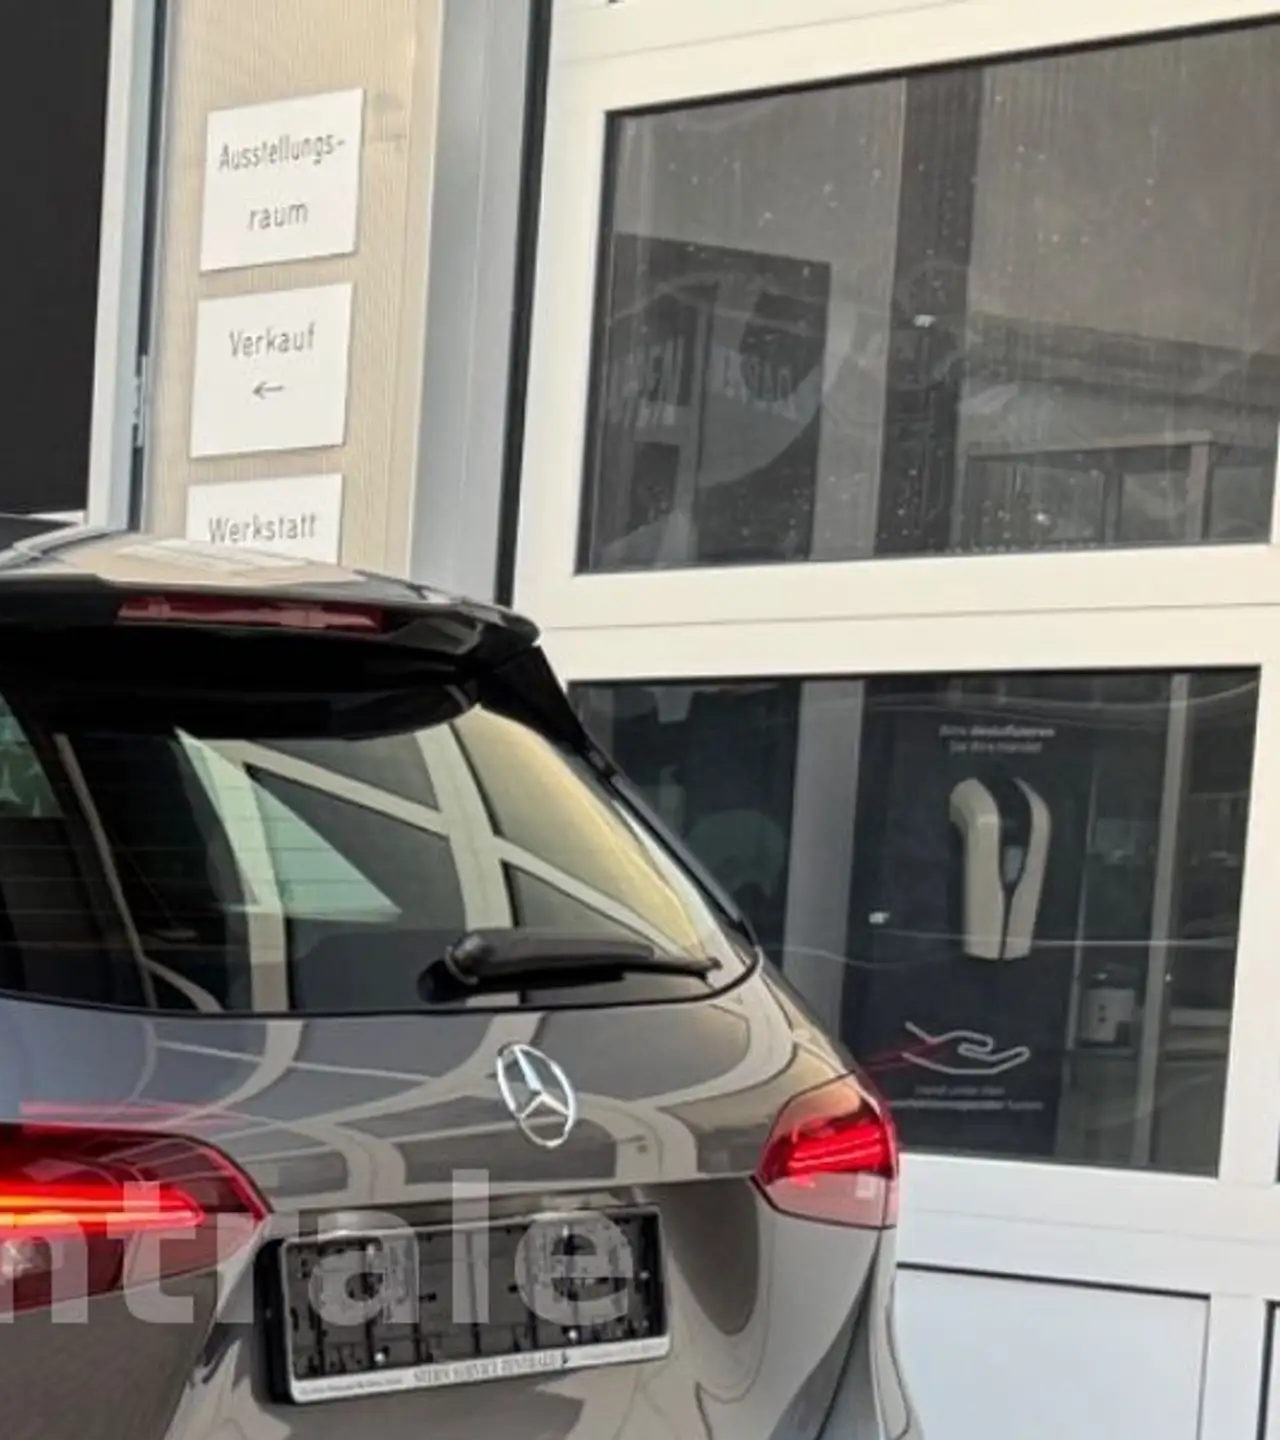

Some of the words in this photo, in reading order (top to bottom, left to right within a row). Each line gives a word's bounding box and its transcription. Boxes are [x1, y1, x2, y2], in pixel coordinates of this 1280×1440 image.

[217, 134, 345, 173] Ausstellungs-
[247, 203, 309, 231] raum
[229, 321, 315, 357] Verkauf
[208, 513, 316, 544] Werkstatt
